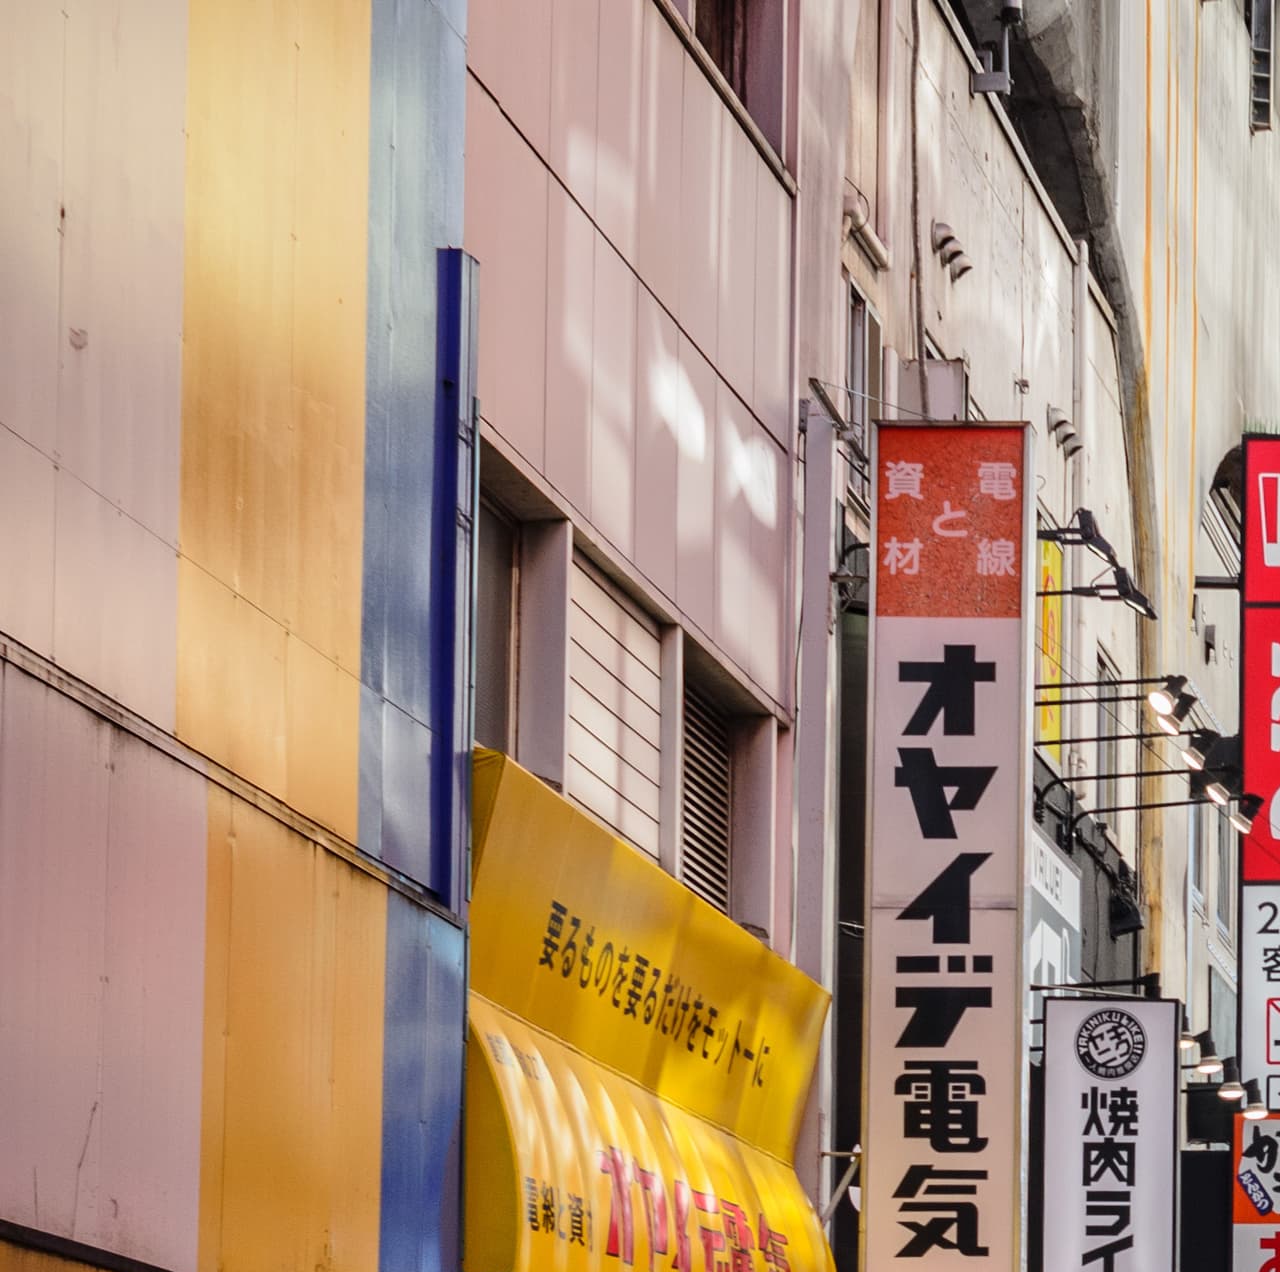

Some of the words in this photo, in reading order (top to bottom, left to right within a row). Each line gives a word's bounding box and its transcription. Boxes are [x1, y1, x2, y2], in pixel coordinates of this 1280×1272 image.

[893, 645, 998, 1258] オヤイデ電気
